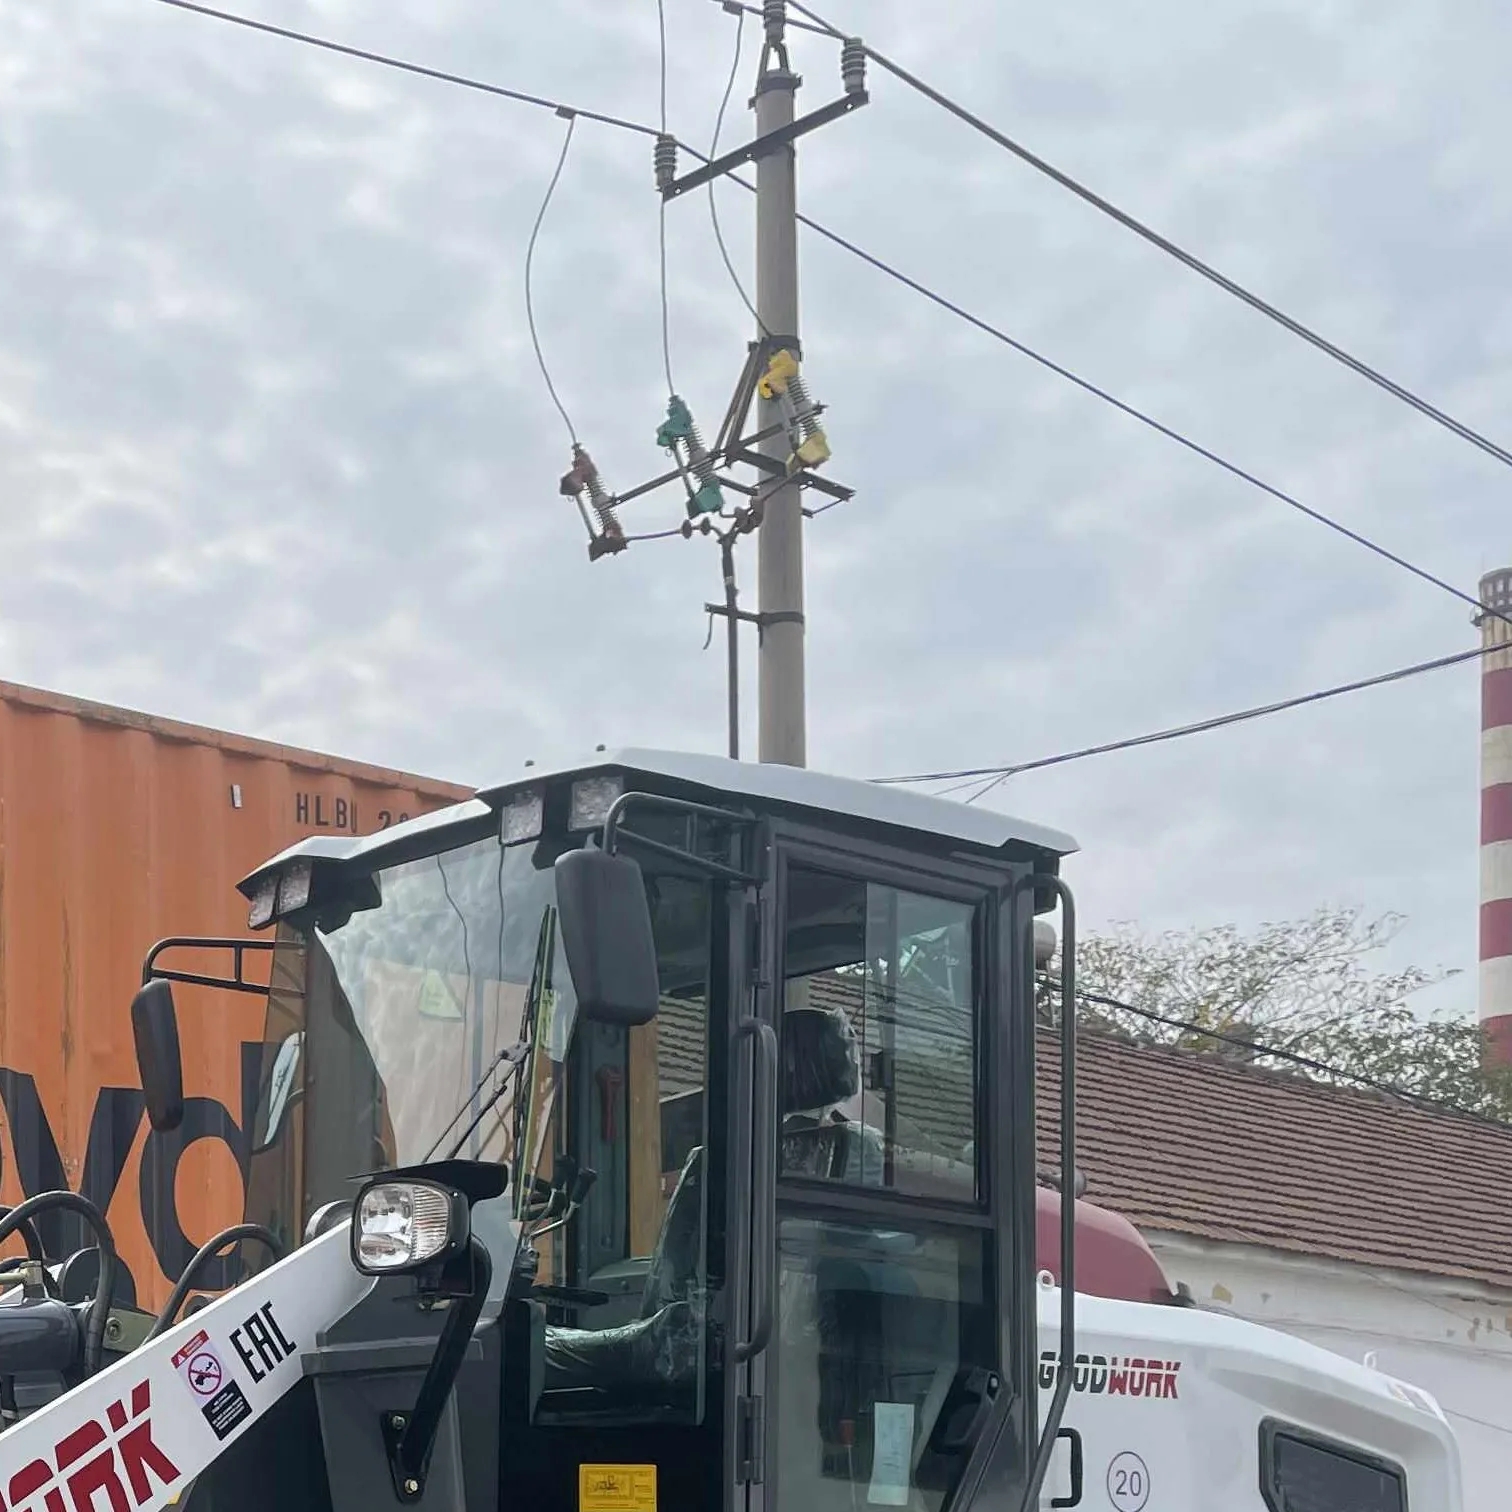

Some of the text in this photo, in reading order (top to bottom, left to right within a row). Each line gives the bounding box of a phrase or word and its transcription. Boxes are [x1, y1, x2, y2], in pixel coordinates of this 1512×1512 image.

[296, 792, 358, 834] HLBU
[1039, 1351, 1181, 1399] GODWORK
[1115, 1469, 1142, 1497] 20
